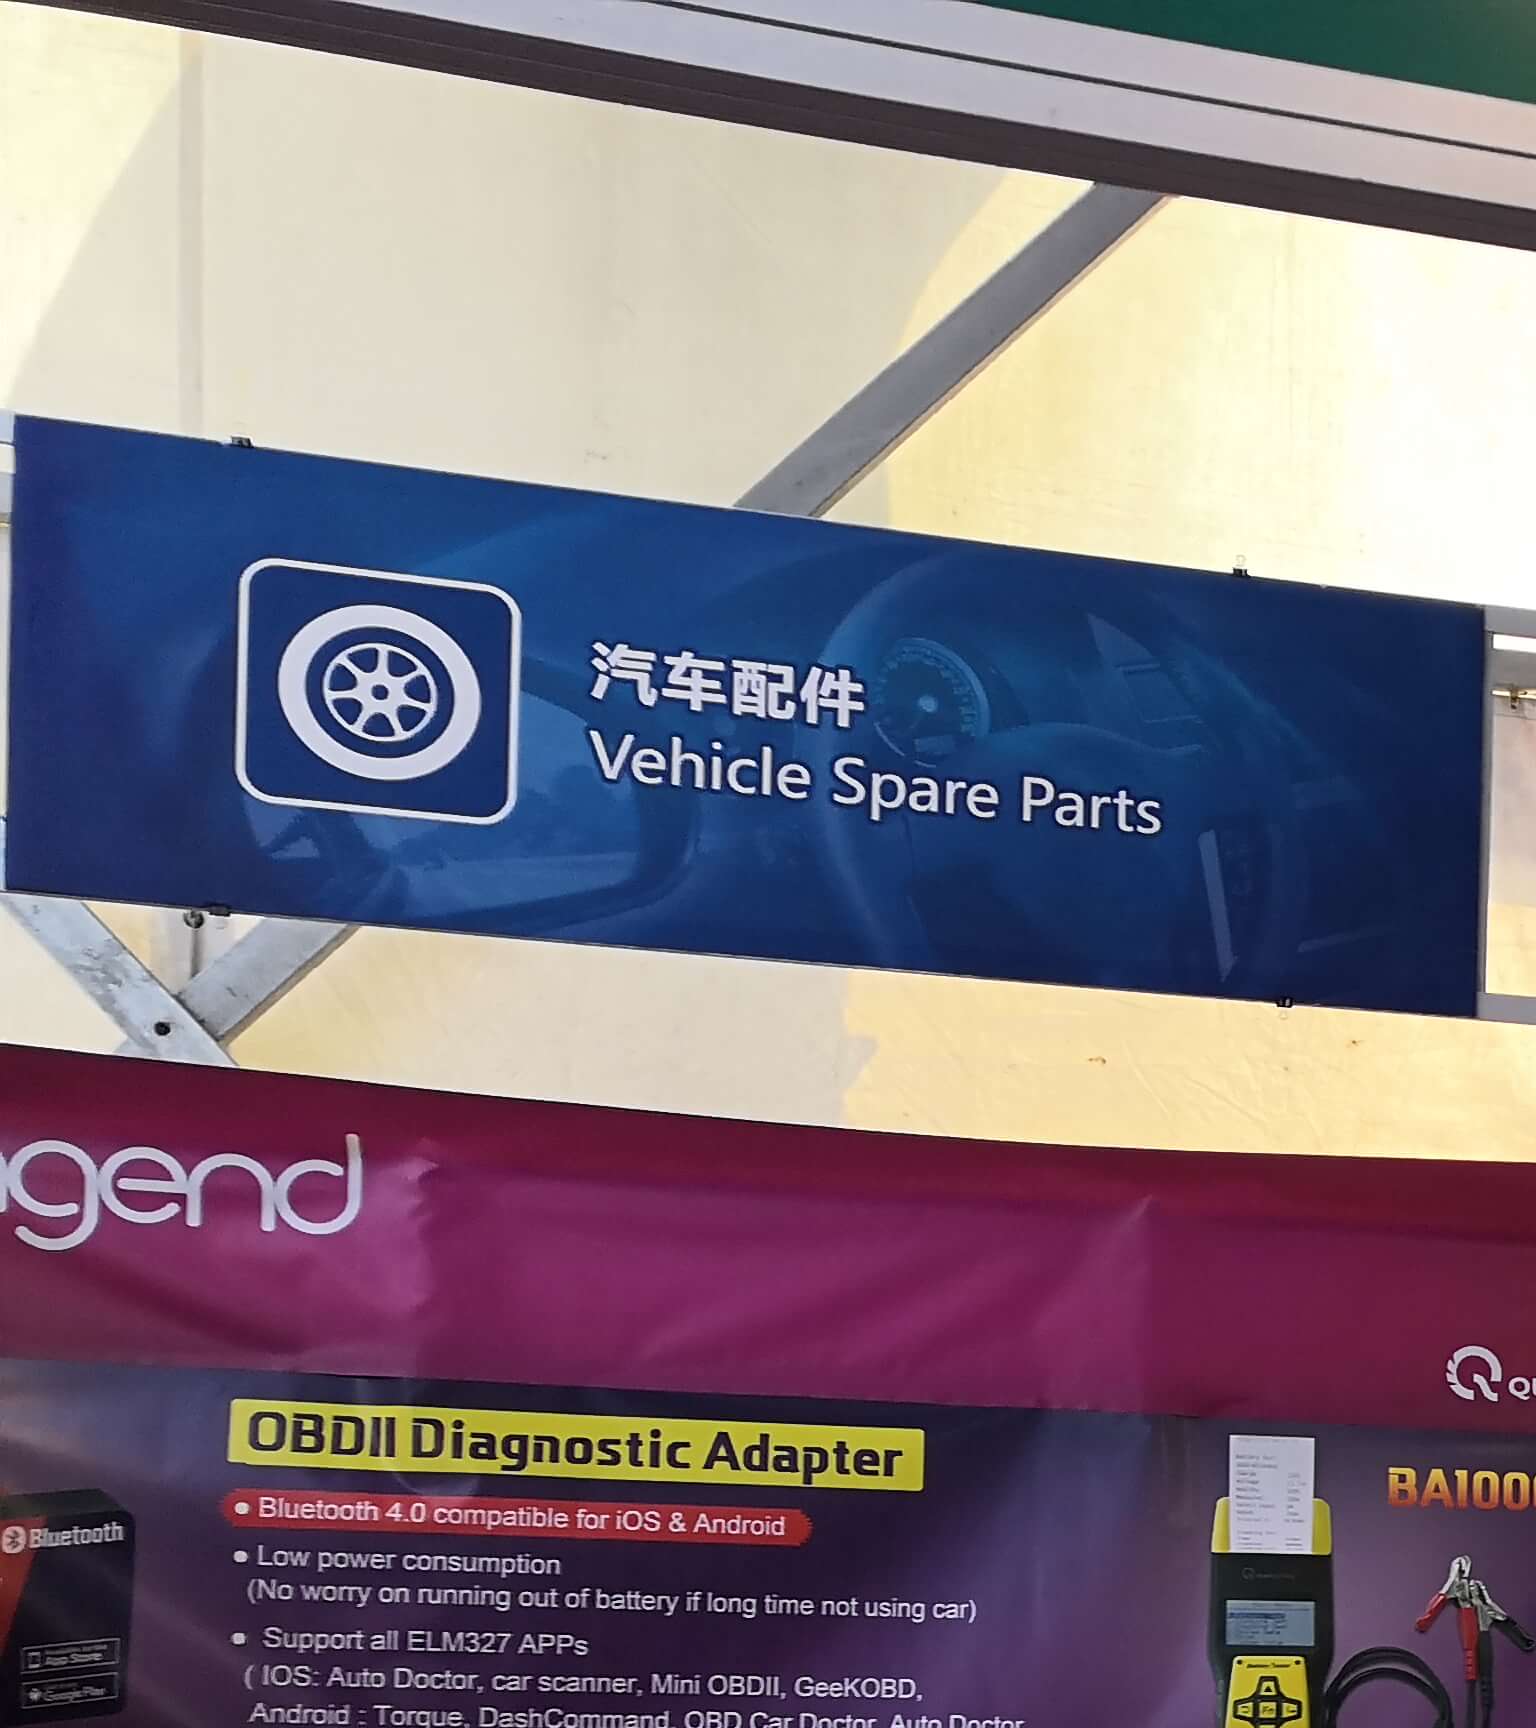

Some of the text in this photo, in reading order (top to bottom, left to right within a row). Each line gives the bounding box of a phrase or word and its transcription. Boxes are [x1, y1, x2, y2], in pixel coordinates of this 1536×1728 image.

[590, 641, 866, 728] 汽车配件
[590, 730, 1160, 834] Vehicle Spare Parts
[249, 1411, 903, 1484] OBDII Diagnostic Adapter
[30, 1523, 125, 1549] Bluetooth
[259, 1497, 785, 1536] Bluetooth 4.0 compatible for iOS Android
[258, 1545, 560, 1578] Low power consumption
[263, 1627, 588, 1655] Support all ELM327 APPs
